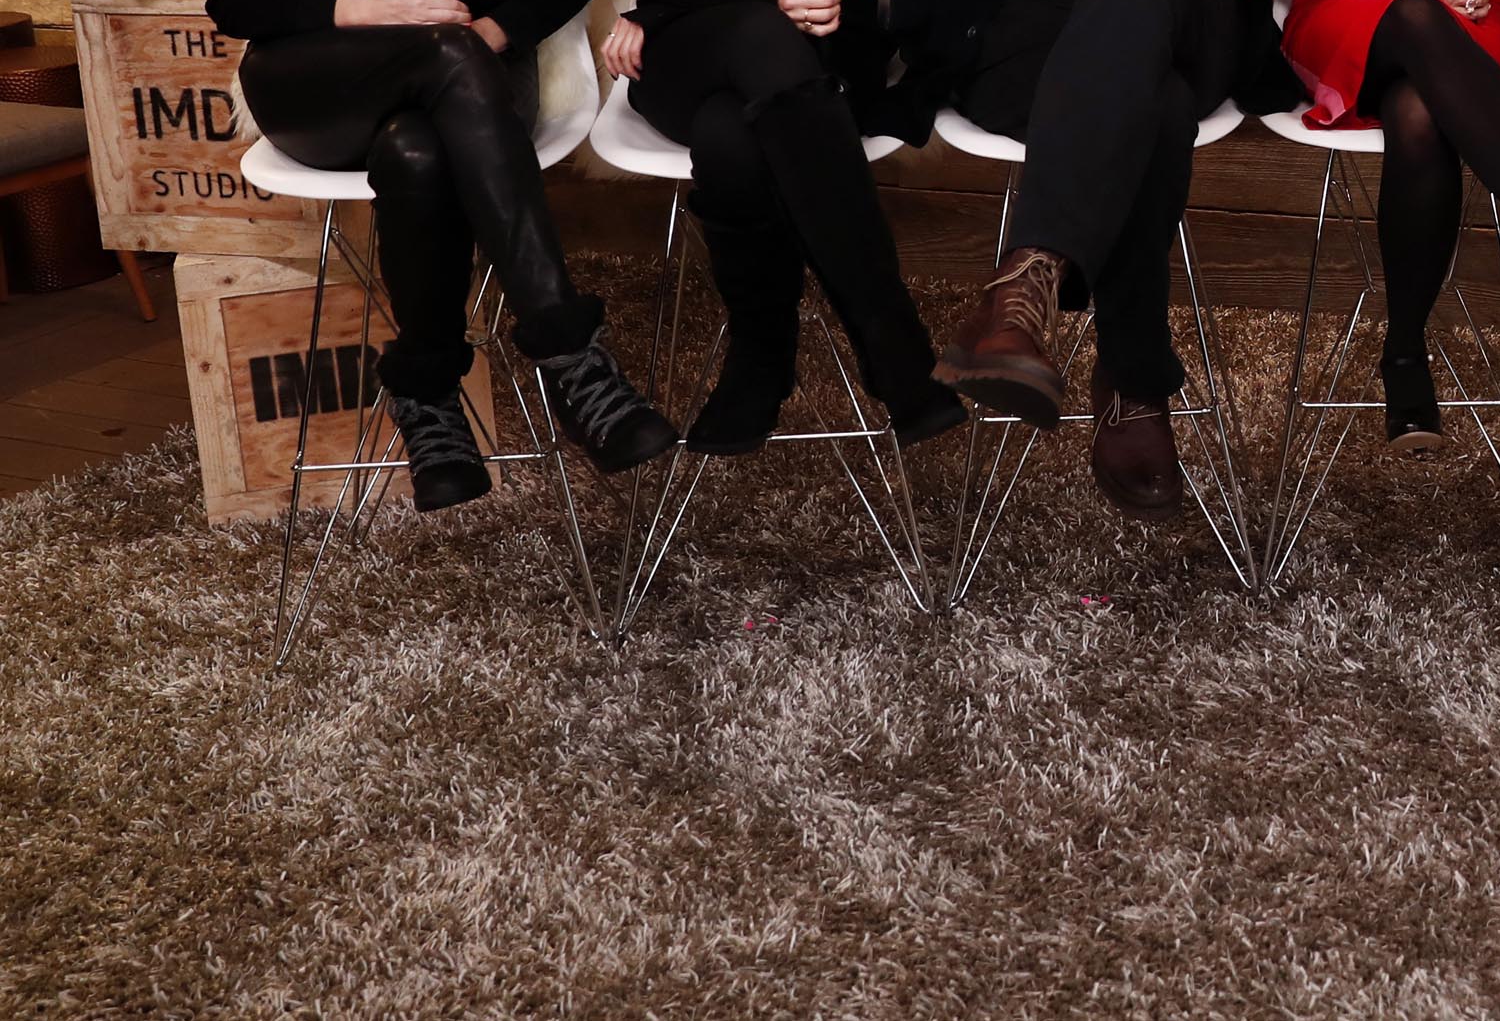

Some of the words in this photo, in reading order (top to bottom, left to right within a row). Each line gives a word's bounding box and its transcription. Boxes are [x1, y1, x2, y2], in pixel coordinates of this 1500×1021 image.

[165, 29, 228, 59] THE
[132, 87, 238, 141] IMD
[249, 343, 384, 422] IMD
